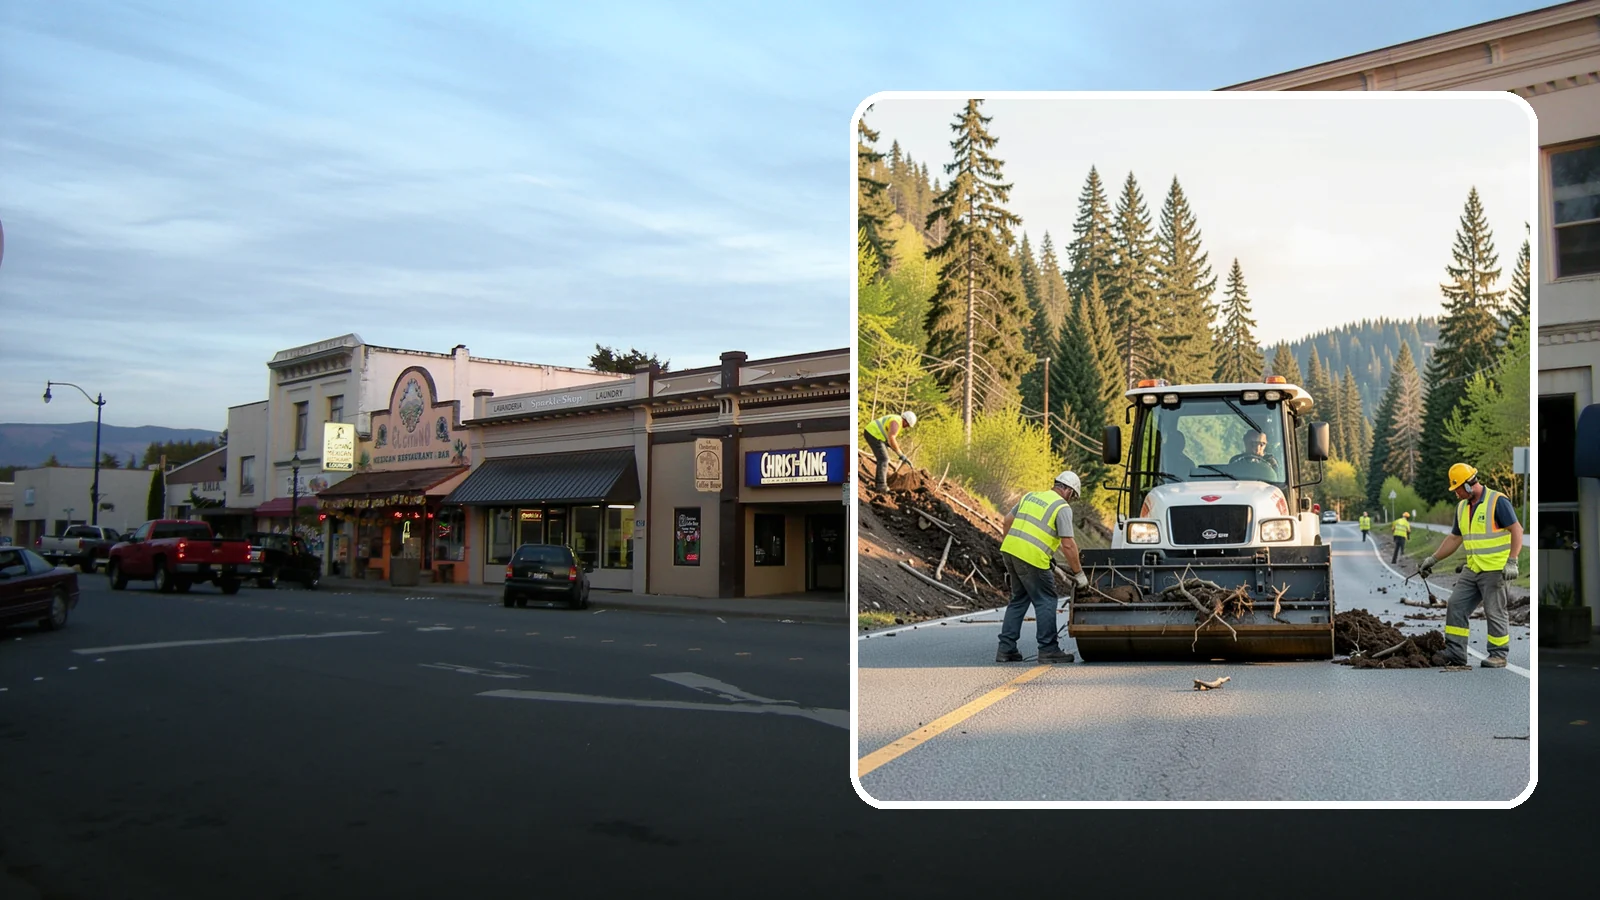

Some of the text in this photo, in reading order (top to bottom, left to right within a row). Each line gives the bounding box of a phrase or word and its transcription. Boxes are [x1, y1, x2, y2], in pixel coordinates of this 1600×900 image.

[595, 388, 624, 400] LAUNDRY
[493, 402, 523, 413] LAVANDERIA
[530, 393, 583, 410] Sparkle Shop
[373, 454, 396, 464] MEXICAN
[397, 451, 433, 462] RESTAURANT
[437, 450, 450, 459] BAR
[761, 450, 827, 478] CHRIST KING
[696, 480, 722, 489] Coffee House
